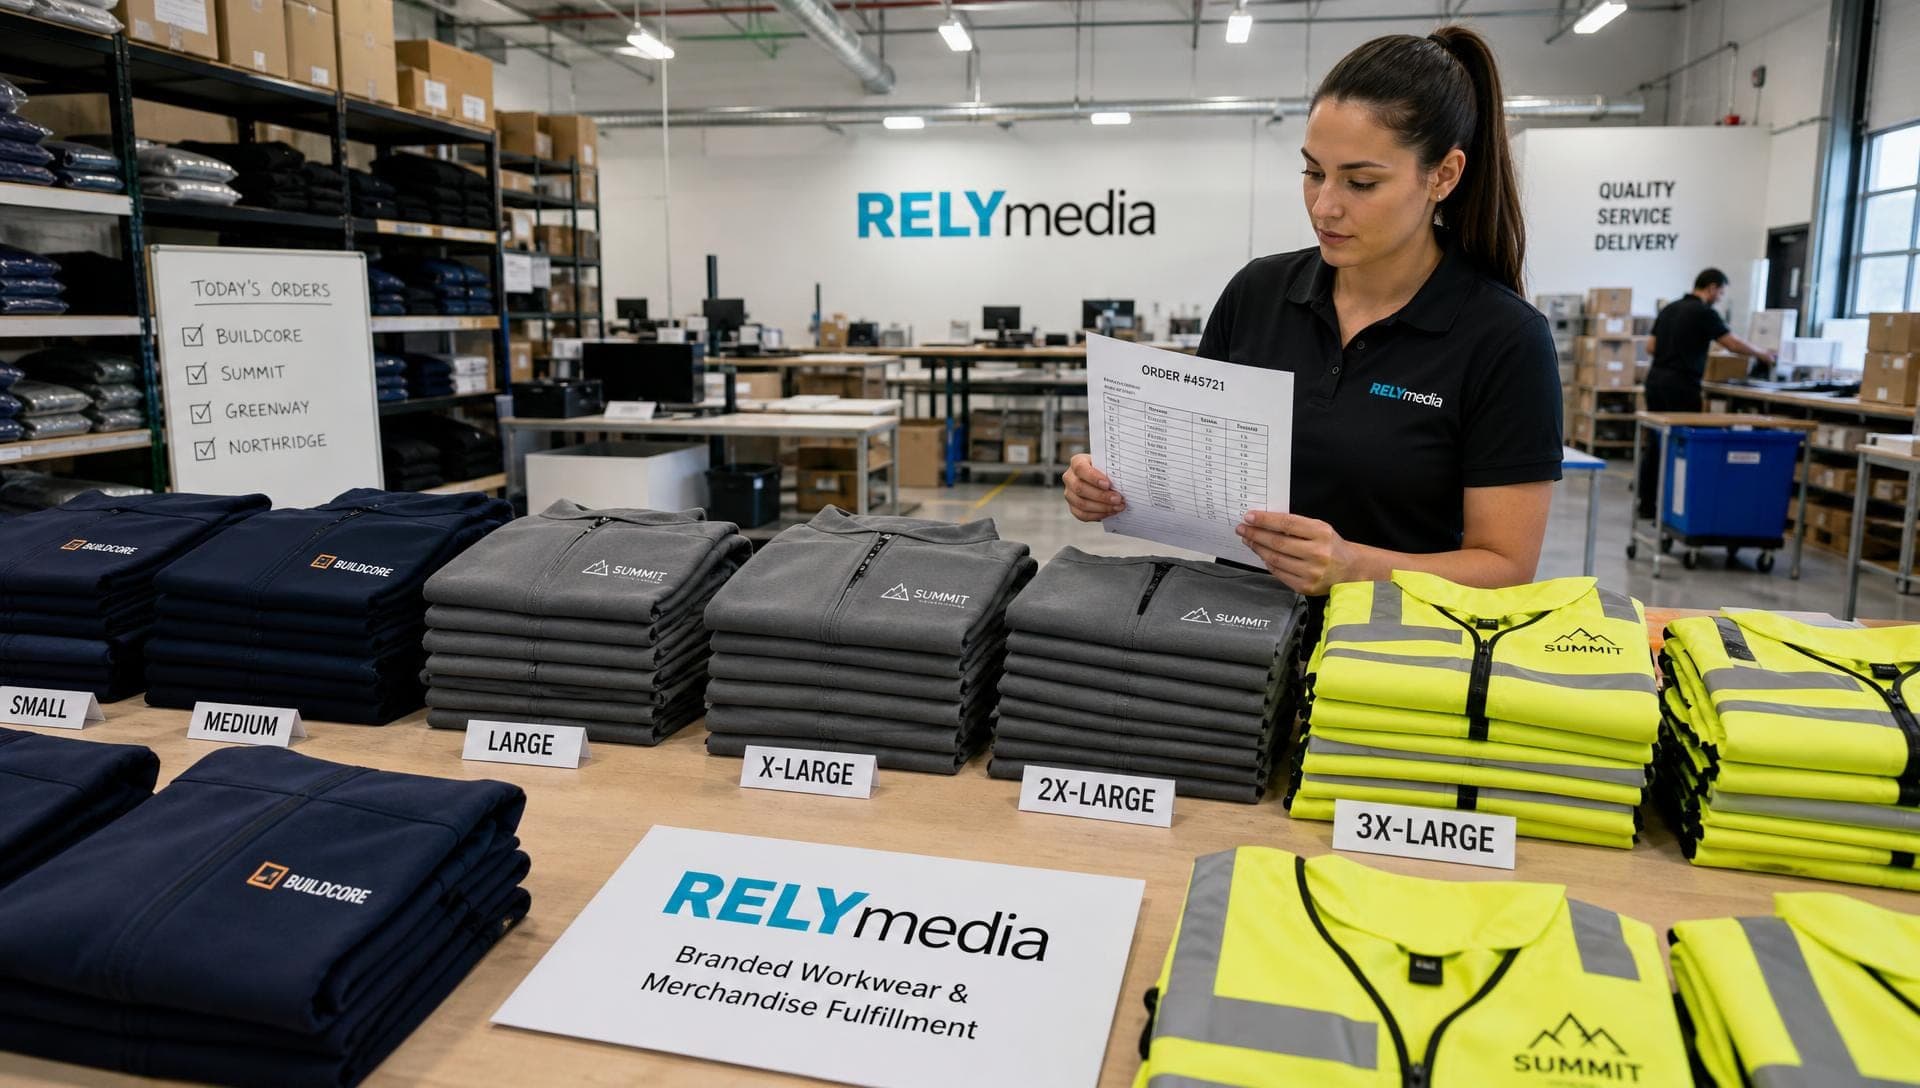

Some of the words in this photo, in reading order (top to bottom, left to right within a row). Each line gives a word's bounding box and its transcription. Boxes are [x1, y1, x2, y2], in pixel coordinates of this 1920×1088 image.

[1599, 181, 1676, 199] QUALITY
[857, 189, 1156, 238] RELYmedia
[1597, 207, 1672, 224] SERVICE
[1595, 233, 1679, 250] DELIVERY
[190, 279, 261, 297] TODAY'S
[271, 281, 331, 298] ORDERS
[216, 327, 303, 344] BUILDCORE
[221, 365, 285, 381] SUMMIT
[1141, 364, 1180, 383] ORDER
[1183, 373, 1225, 392] #45721
[1369, 382, 1443, 409] RELYmedia
[225, 401, 310, 419] GREENWAY
[229, 433, 328, 455] NORTHRIDGE
[333, 559, 394, 578] BUILDCORE
[612, 565, 668, 581] SUMMIT
[913, 589, 970, 605] SUMMIT
[1214, 613, 1271, 628] SUMMIT
[1544, 644, 1624, 655] SUMMIT
[10, 694, 67, 719] SMALL
[203, 711, 279, 736] MEDIUM
[488, 729, 555, 756] LARGE
[758, 755, 855, 786] X-LARGE
[1038, 777, 1156, 813] 2X-LARGE
[1355, 812, 1495, 853] 3X-LARGE
[282, 873, 372, 904] BUILDCORE
[661, 870, 1050, 962] RELYmedia
[675, 945, 793, 979] Branded
[800, 962, 942, 999] Workwear
[948, 983, 969, 1004] &
[641, 972, 818, 1017] Merchandise
[826, 999, 979, 1041] Fulfillment
[1513, 1054, 1643, 1082] SUMMIT
